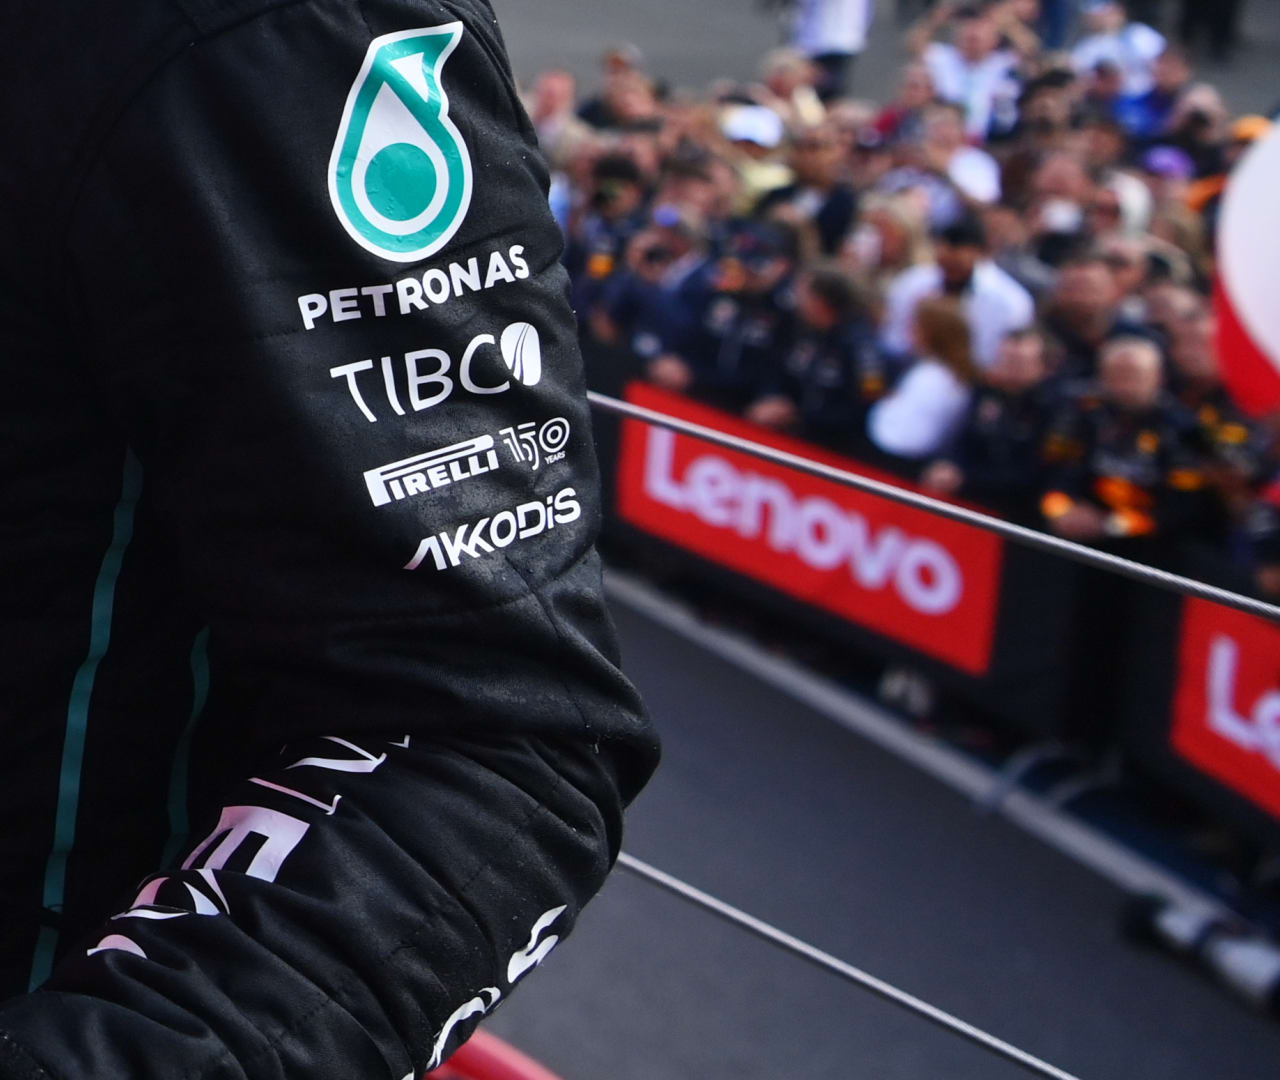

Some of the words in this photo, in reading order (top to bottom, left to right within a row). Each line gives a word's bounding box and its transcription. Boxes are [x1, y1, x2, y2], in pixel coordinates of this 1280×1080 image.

[297, 245, 531, 331] PETRONAS
[363, 434, 500, 508] PIRELLI
[544, 451, 566, 465] YEARS
[645, 415, 963, 617] Lenovo
